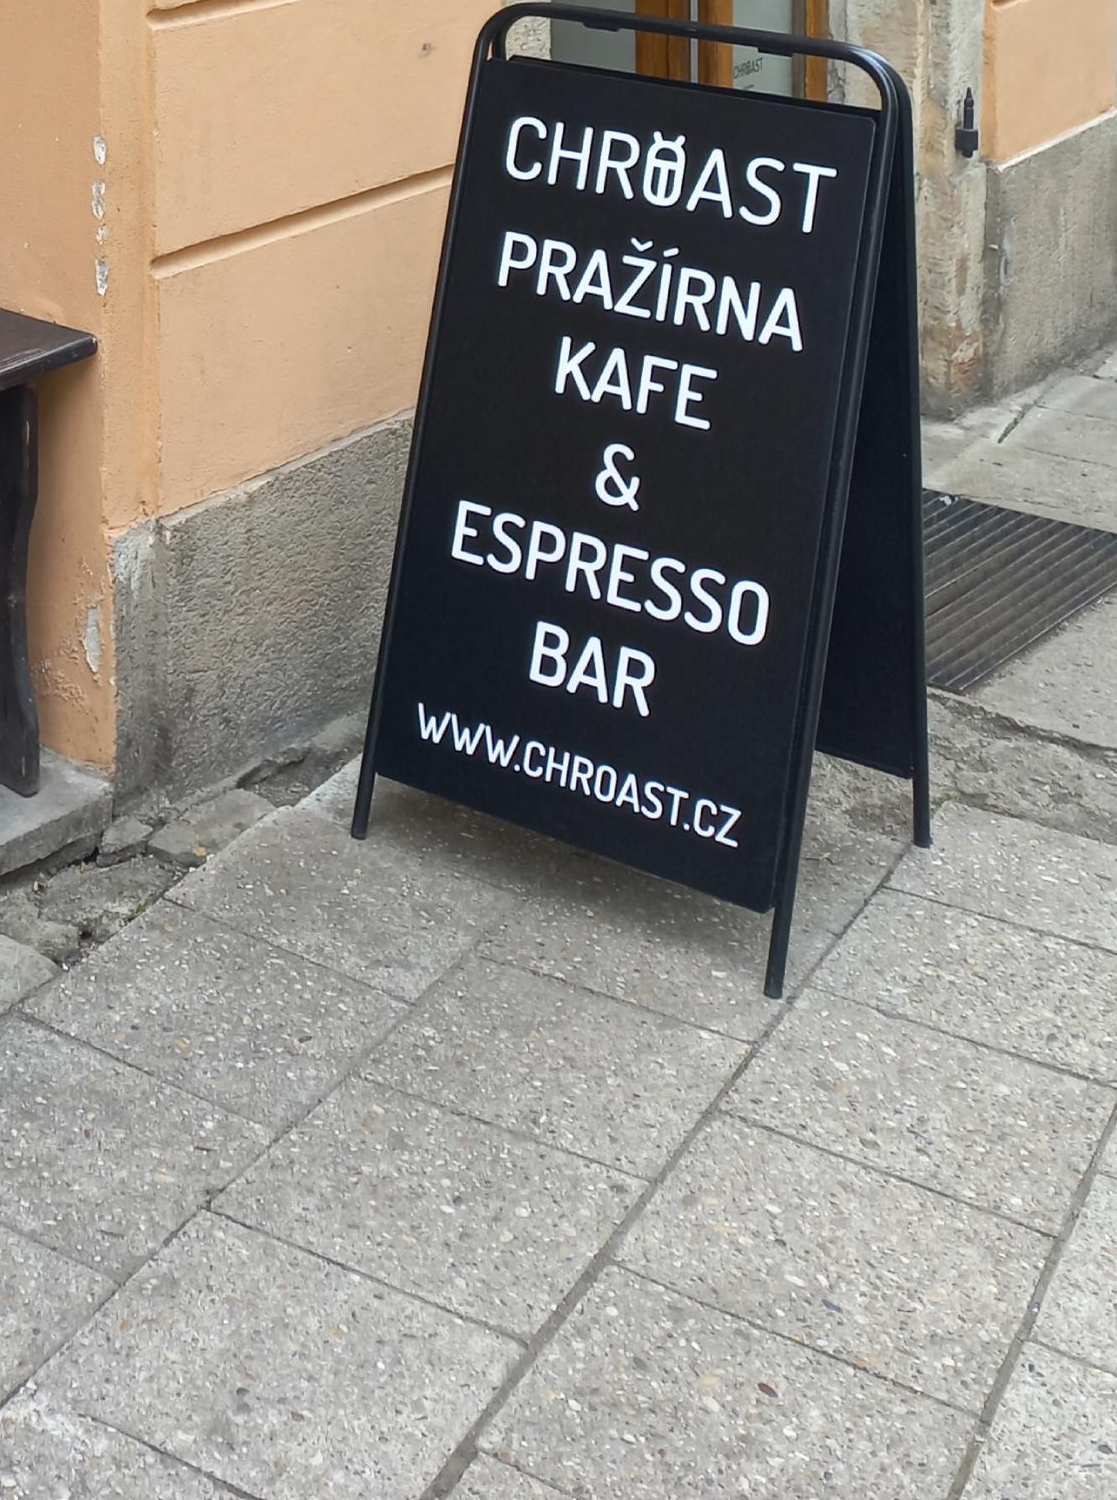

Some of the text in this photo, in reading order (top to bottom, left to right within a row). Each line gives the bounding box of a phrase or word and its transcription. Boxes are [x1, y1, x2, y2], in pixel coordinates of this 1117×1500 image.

[504, 115, 837, 234] CHROAST
[497, 231, 803, 352] PRAŽÍRNA
[554, 336, 718, 430] KAFE
[594, 443, 640, 512] &
[451, 500, 769, 646] ESPRESSO
[529, 621, 655, 717] BAR
[417, 702, 742, 848] WWW.CHROAST.CZ
